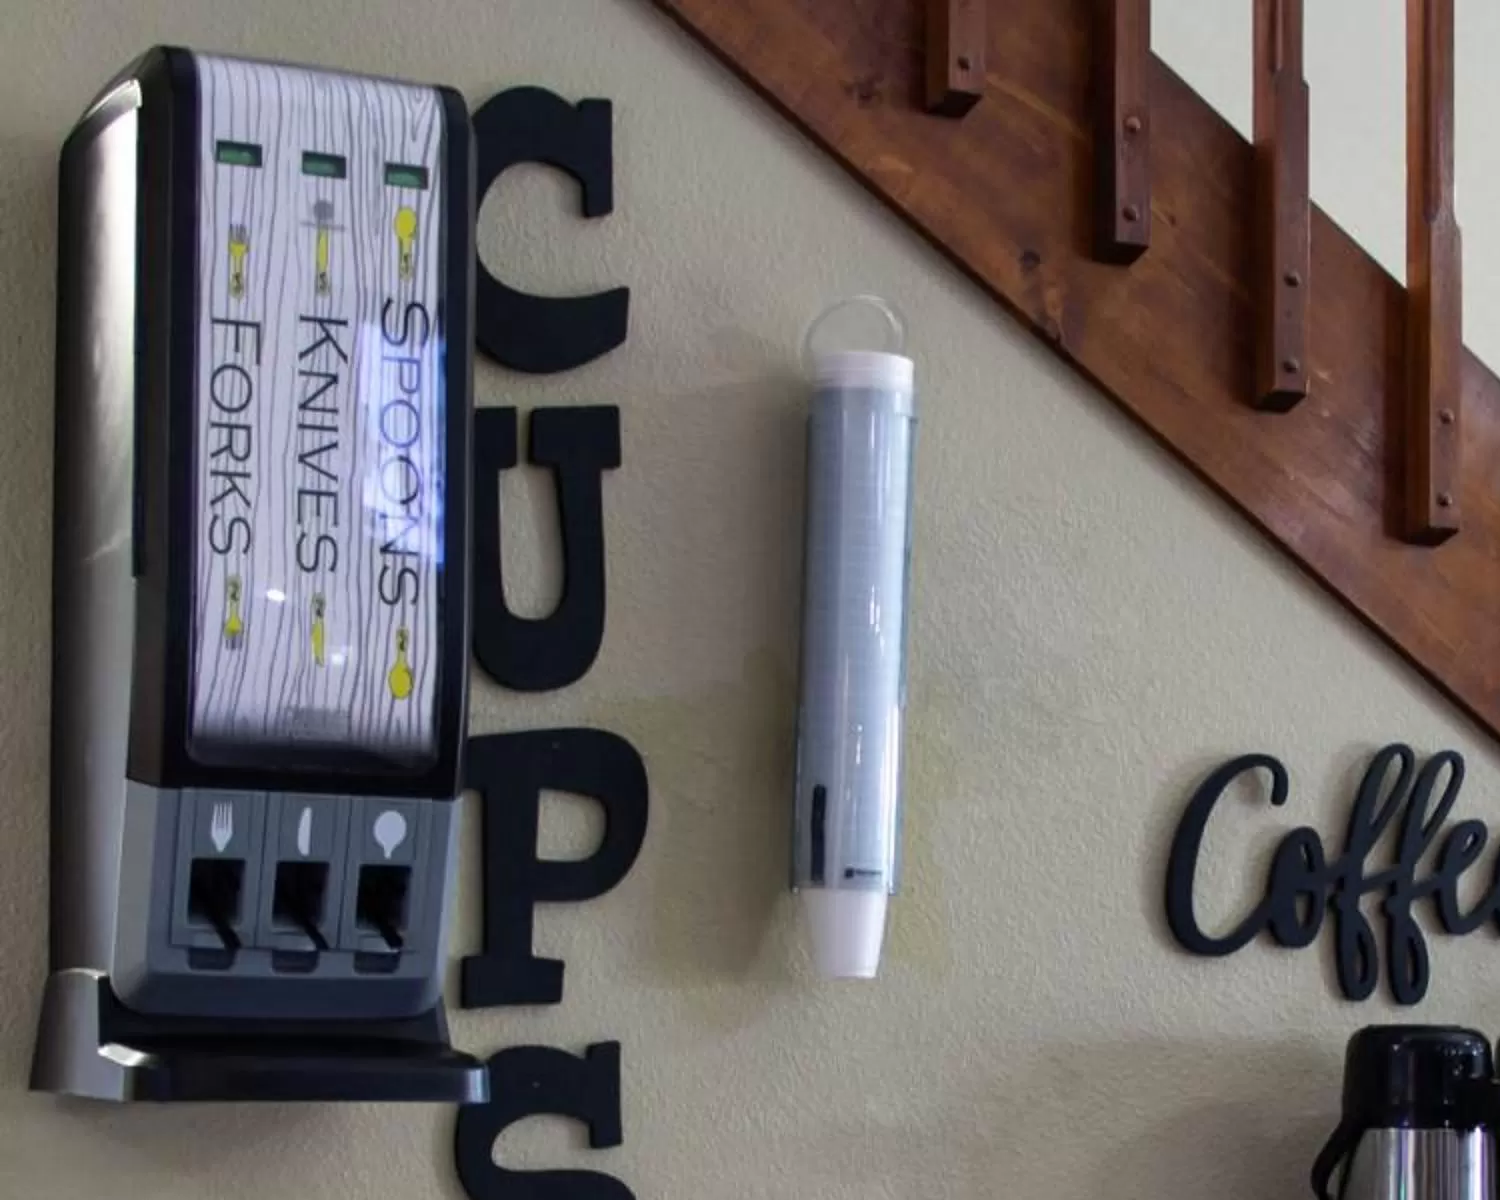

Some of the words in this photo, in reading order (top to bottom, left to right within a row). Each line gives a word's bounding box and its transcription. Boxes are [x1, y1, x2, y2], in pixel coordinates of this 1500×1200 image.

[209, 317, 261, 557] FORKS
[295, 315, 349, 574] KNIVES
[379, 296, 428, 607] SPOONS
